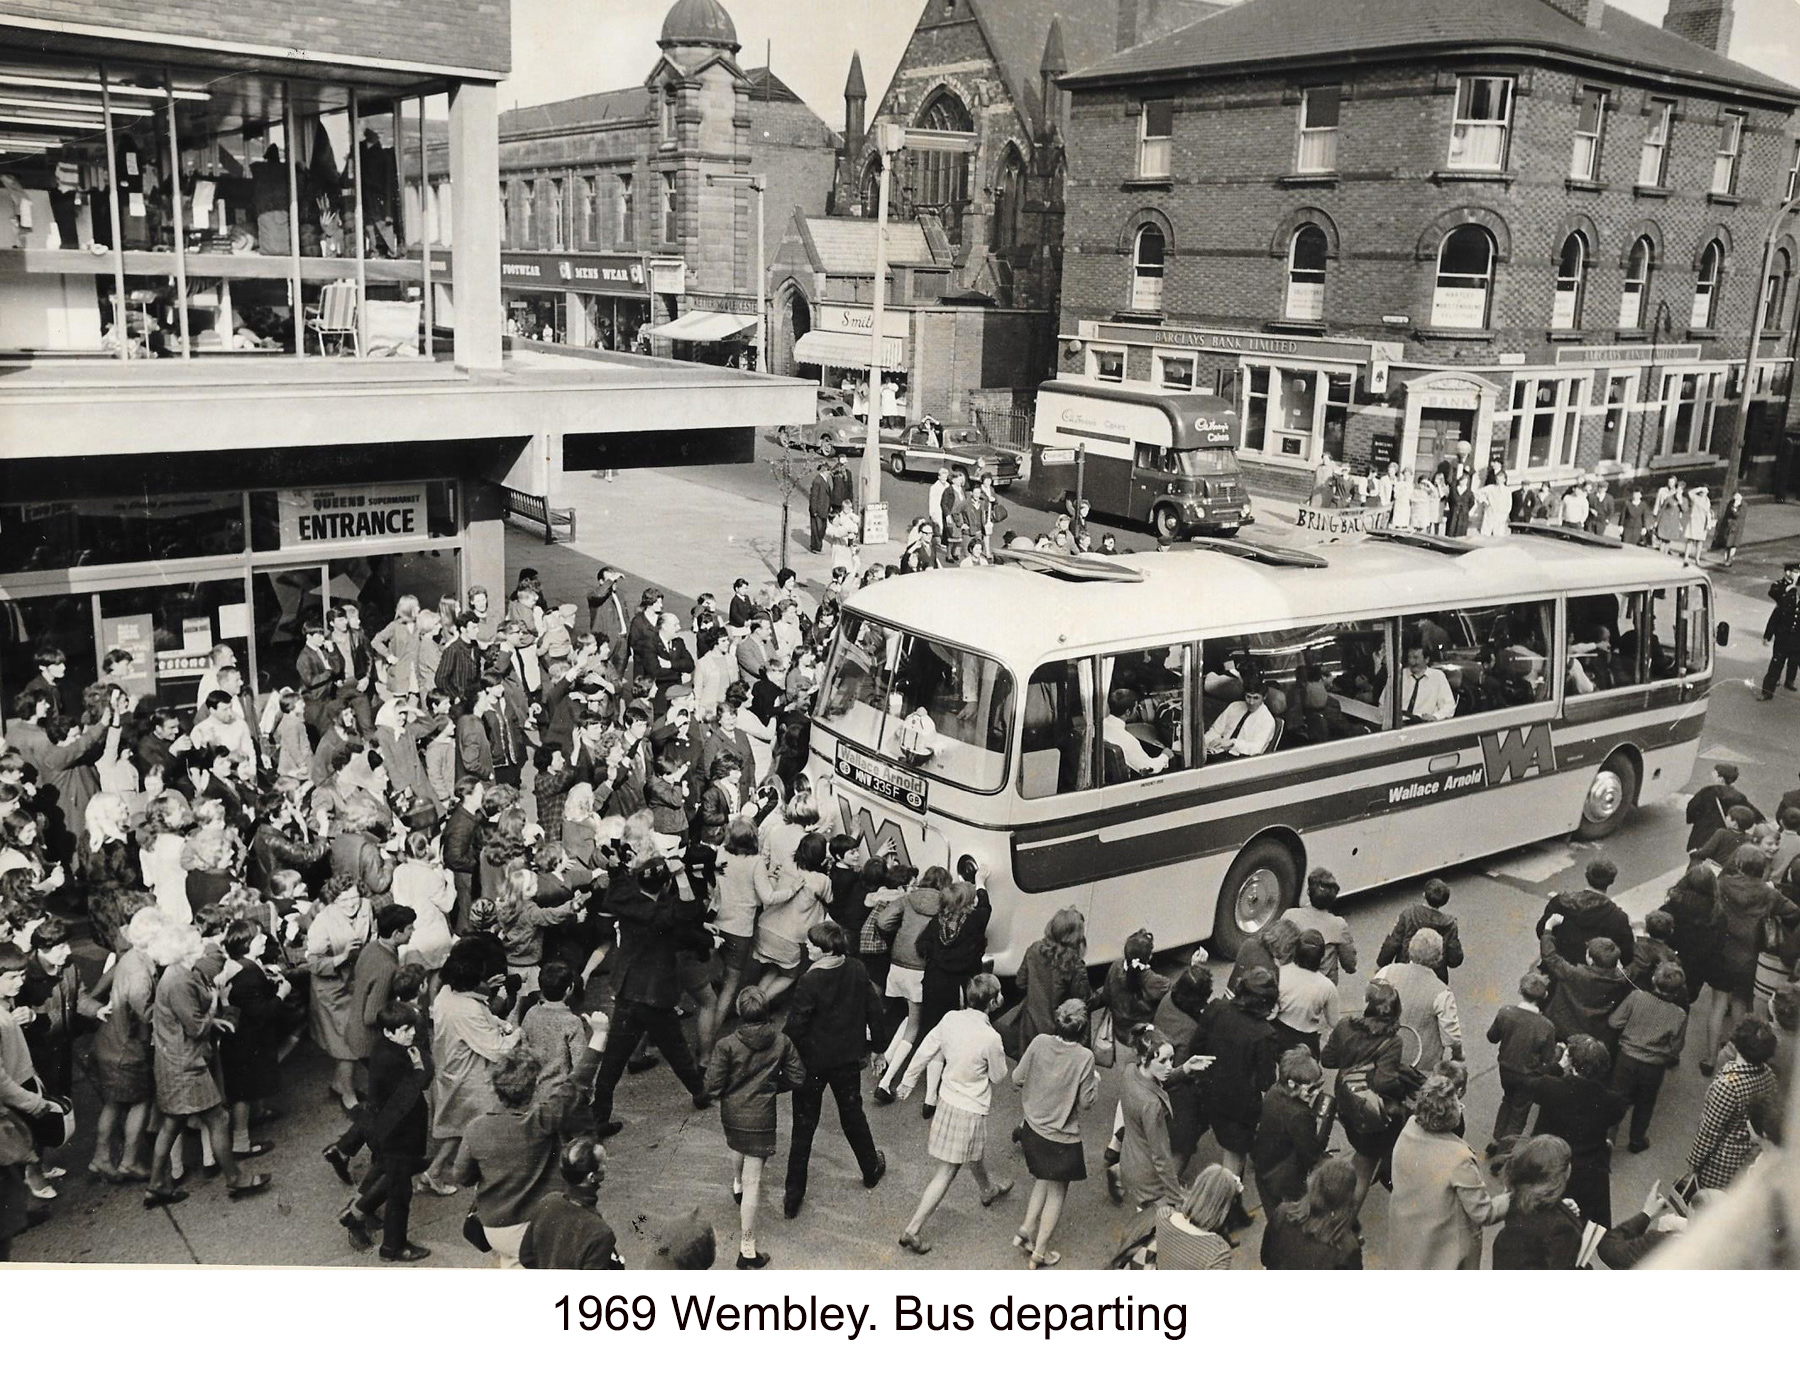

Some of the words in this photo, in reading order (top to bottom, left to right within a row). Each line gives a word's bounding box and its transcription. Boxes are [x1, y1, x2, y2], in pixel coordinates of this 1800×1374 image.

[502, 264, 541, 277] FOOTWEAR
[575, 267, 599, 279] MENS
[602, 269, 629, 281] WEAR
[729, 299, 758, 314] LEICESTE
[1155, 331, 1205, 347] BARCLAYS
[1212, 336, 1242, 349] BANK
[1250, 339, 1298, 353] LIMITED
[1584, 350, 1621, 361] BARCLAYS
[1625, 350, 1646, 361] BANK
[1429, 396, 1471, 408] BANK
[1207, 432, 1230, 443] Cakes
[313, 496, 365, 511] QUEENS
[368, 494, 421, 506] SUPERMARKET
[299, 508, 415, 540] ENTRANCE
[1296, 508, 1339, 533] BRING
[1340, 517, 1368, 533] BACK
[840, 744, 880, 775] Wallace
[883, 768, 922, 794] Arnold
[1388, 782, 1439, 803] Wallace
[1444, 768, 1483, 791] Arnold
[908, 793, 920, 806] GB
